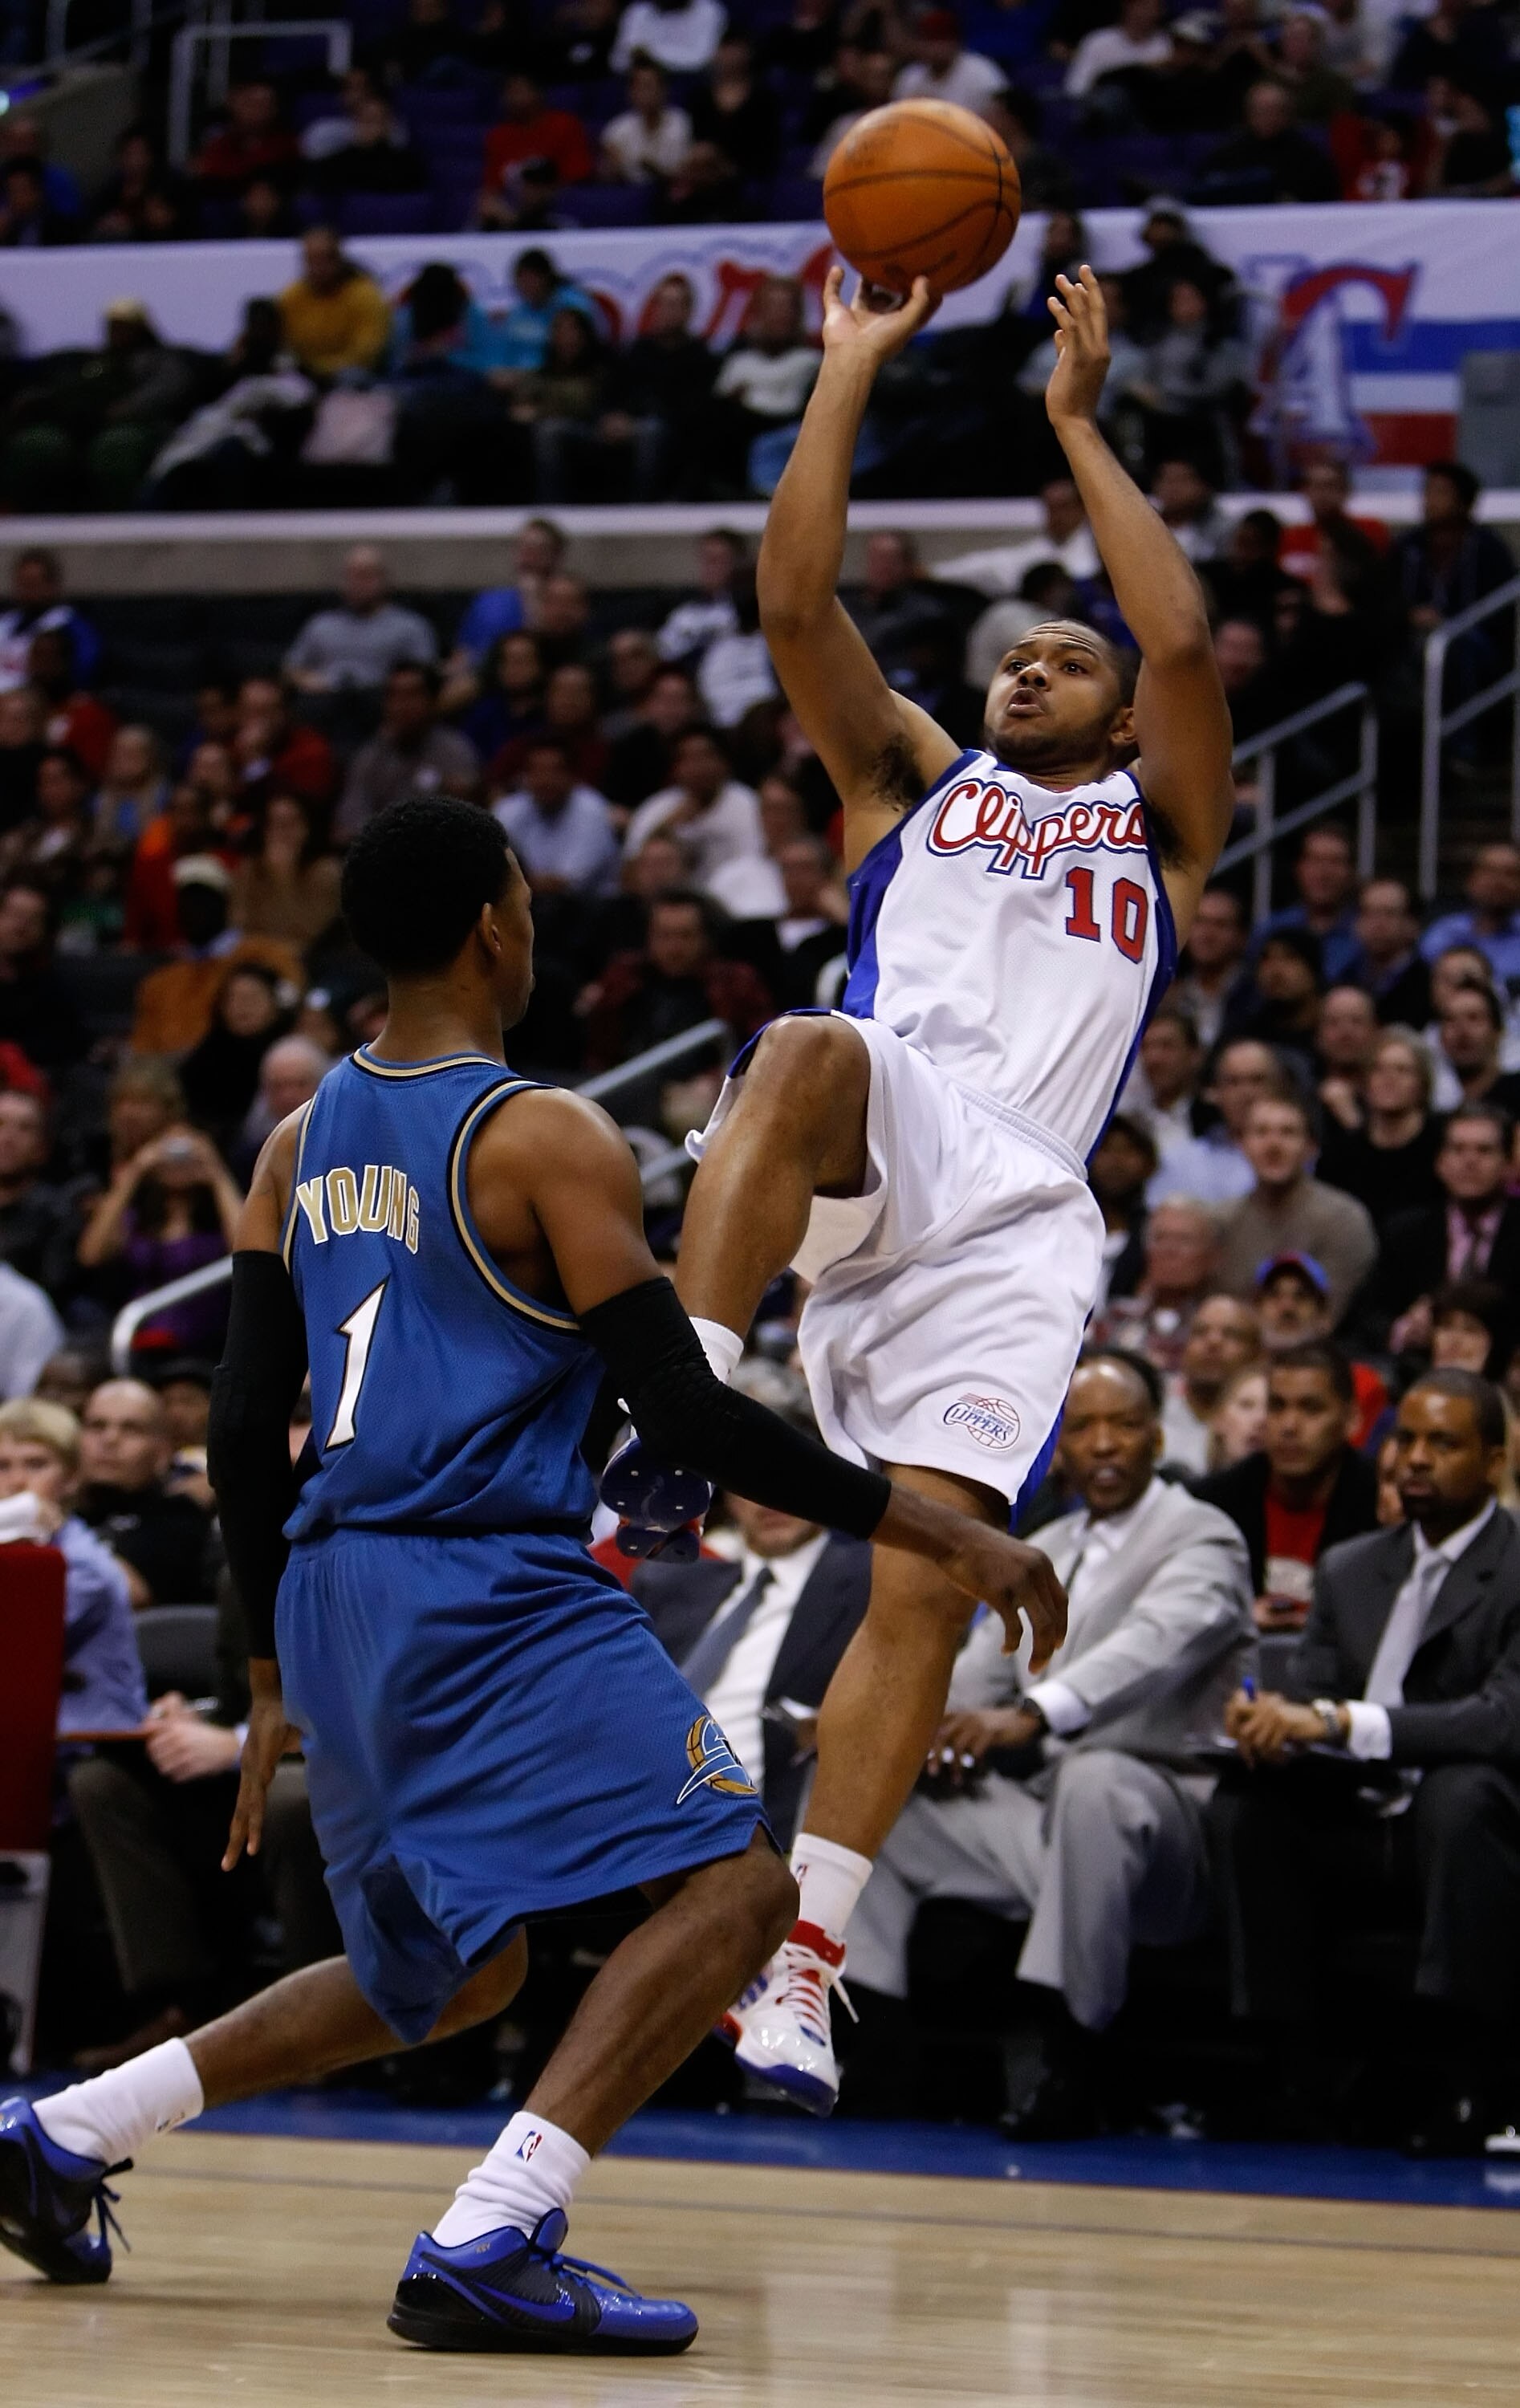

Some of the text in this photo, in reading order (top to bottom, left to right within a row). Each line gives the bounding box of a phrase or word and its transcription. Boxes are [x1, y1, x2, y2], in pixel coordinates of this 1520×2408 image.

[927, 778, 1148, 880] Clippers
[1066, 866, 1148, 964] 10
[295, 1165, 420, 1255] YOUNG
[324, 1272, 392, 1452] 1
[943, 1402, 1008, 1442] CLIPPERS
